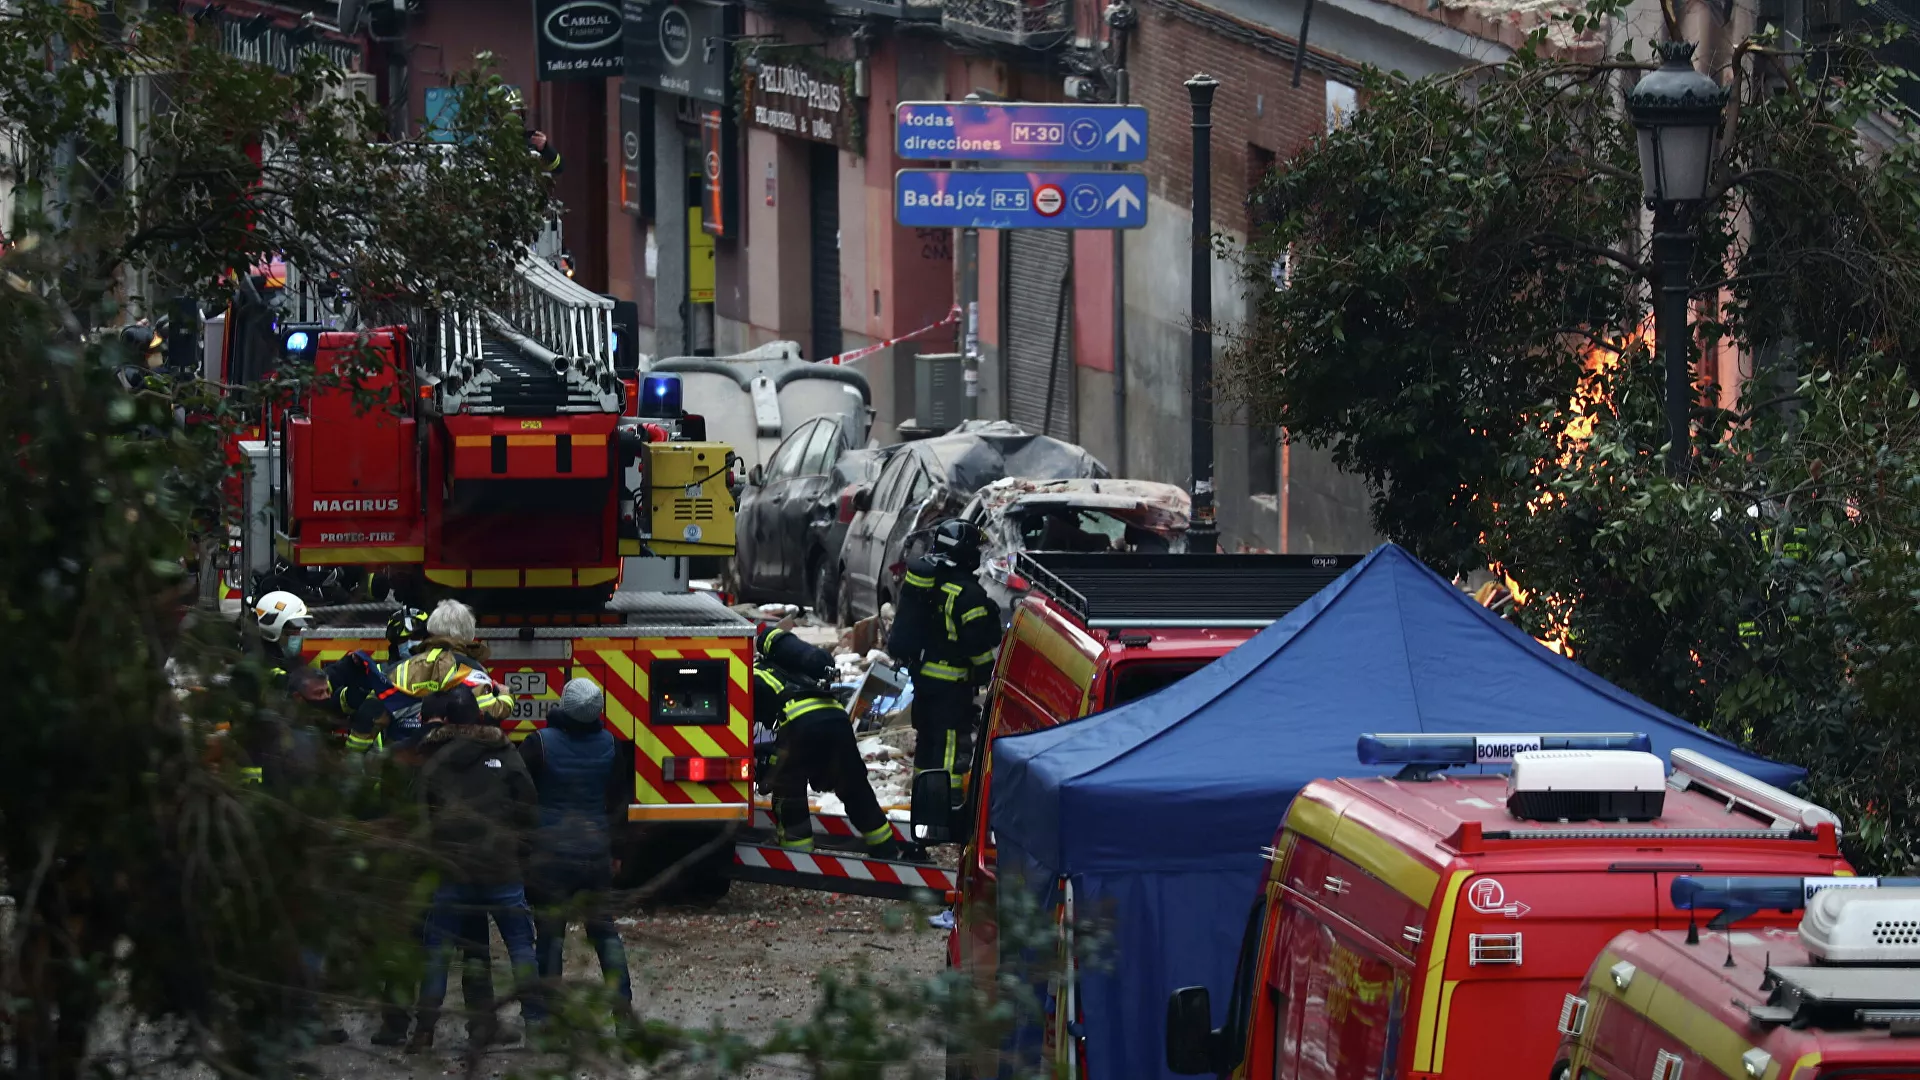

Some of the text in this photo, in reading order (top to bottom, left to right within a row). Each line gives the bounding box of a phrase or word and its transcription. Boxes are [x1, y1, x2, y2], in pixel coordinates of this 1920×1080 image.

[558, 13, 612, 27] CARISAL
[547, 59, 573, 70] Tallas
[575, 57, 589, 69] de
[591, 56, 604, 68] 44
[605, 58, 613, 67] a
[808, 80, 840, 112] PARIS
[906, 113, 1061, 142] todas M-30
[904, 135, 1002, 151] direcciones
[904, 189, 986, 210] Badajoz
[995, 192, 1026, 207] R-5
[313, 498, 399, 512] MAGIRUS
